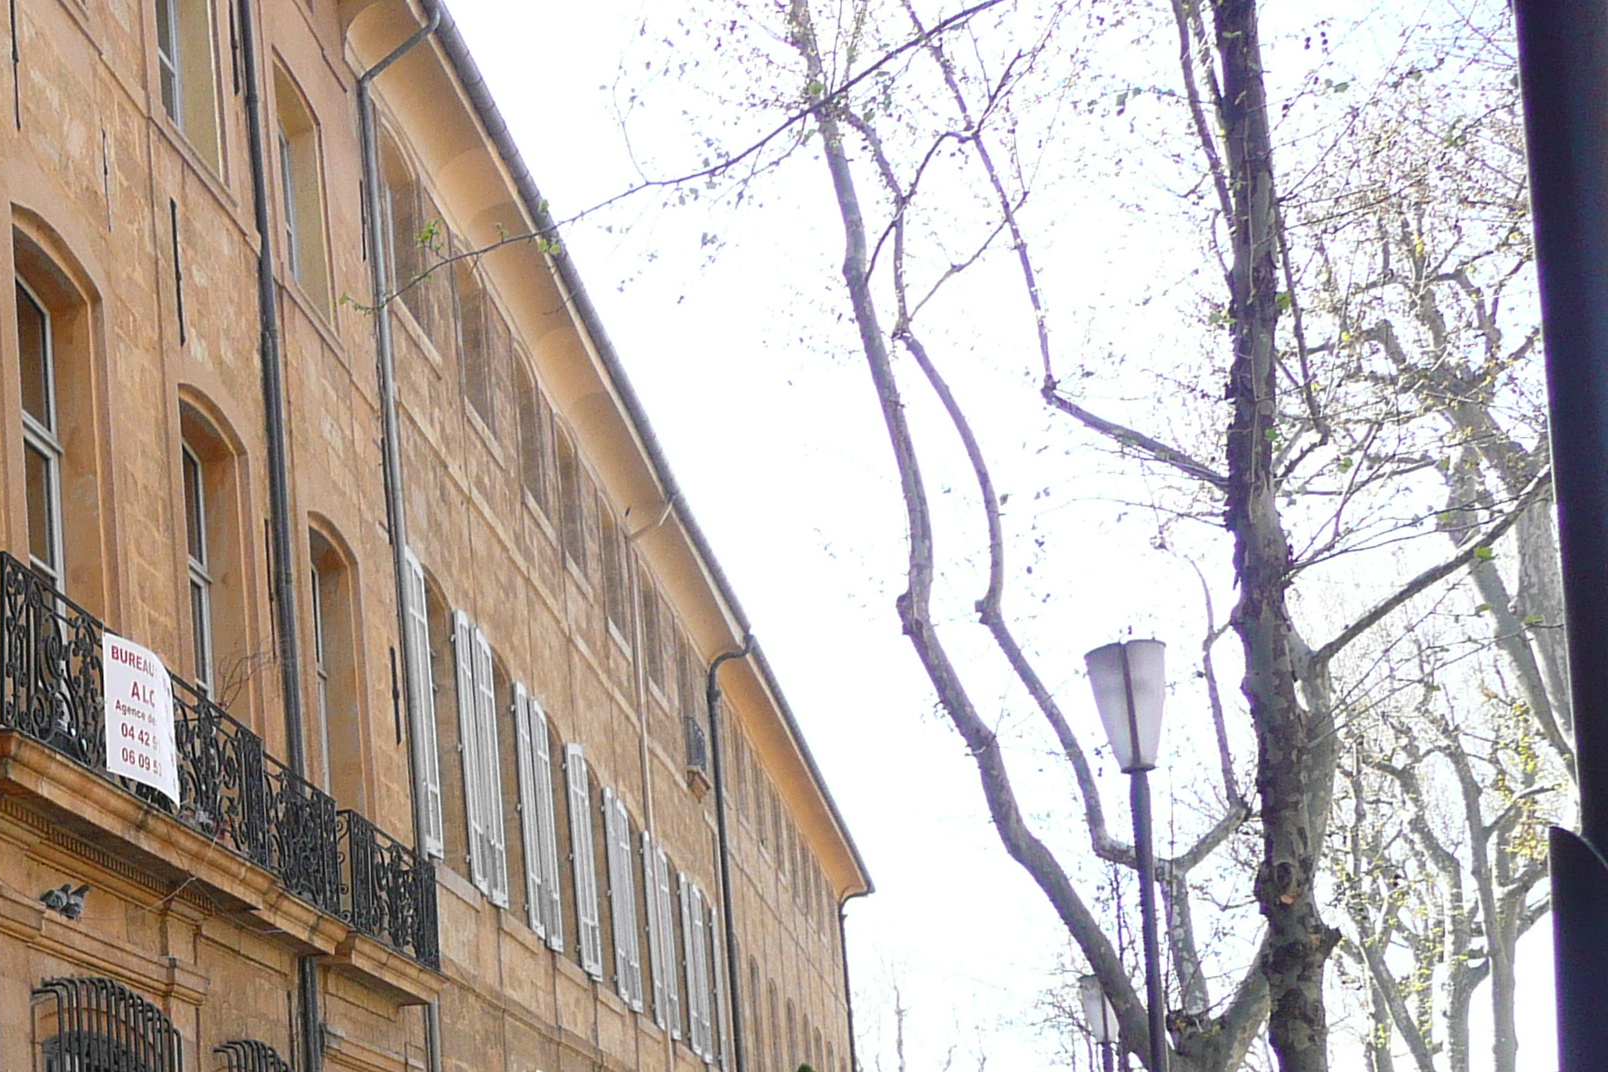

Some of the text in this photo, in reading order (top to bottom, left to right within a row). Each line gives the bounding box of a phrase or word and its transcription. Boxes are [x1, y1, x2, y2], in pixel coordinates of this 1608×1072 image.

[115, 699, 146, 720] Agence
[121, 722, 135, 740] 04
[138, 729, 150, 747] 42
[122, 747, 135, 765] 06
[138, 753, 151, 771] 09
